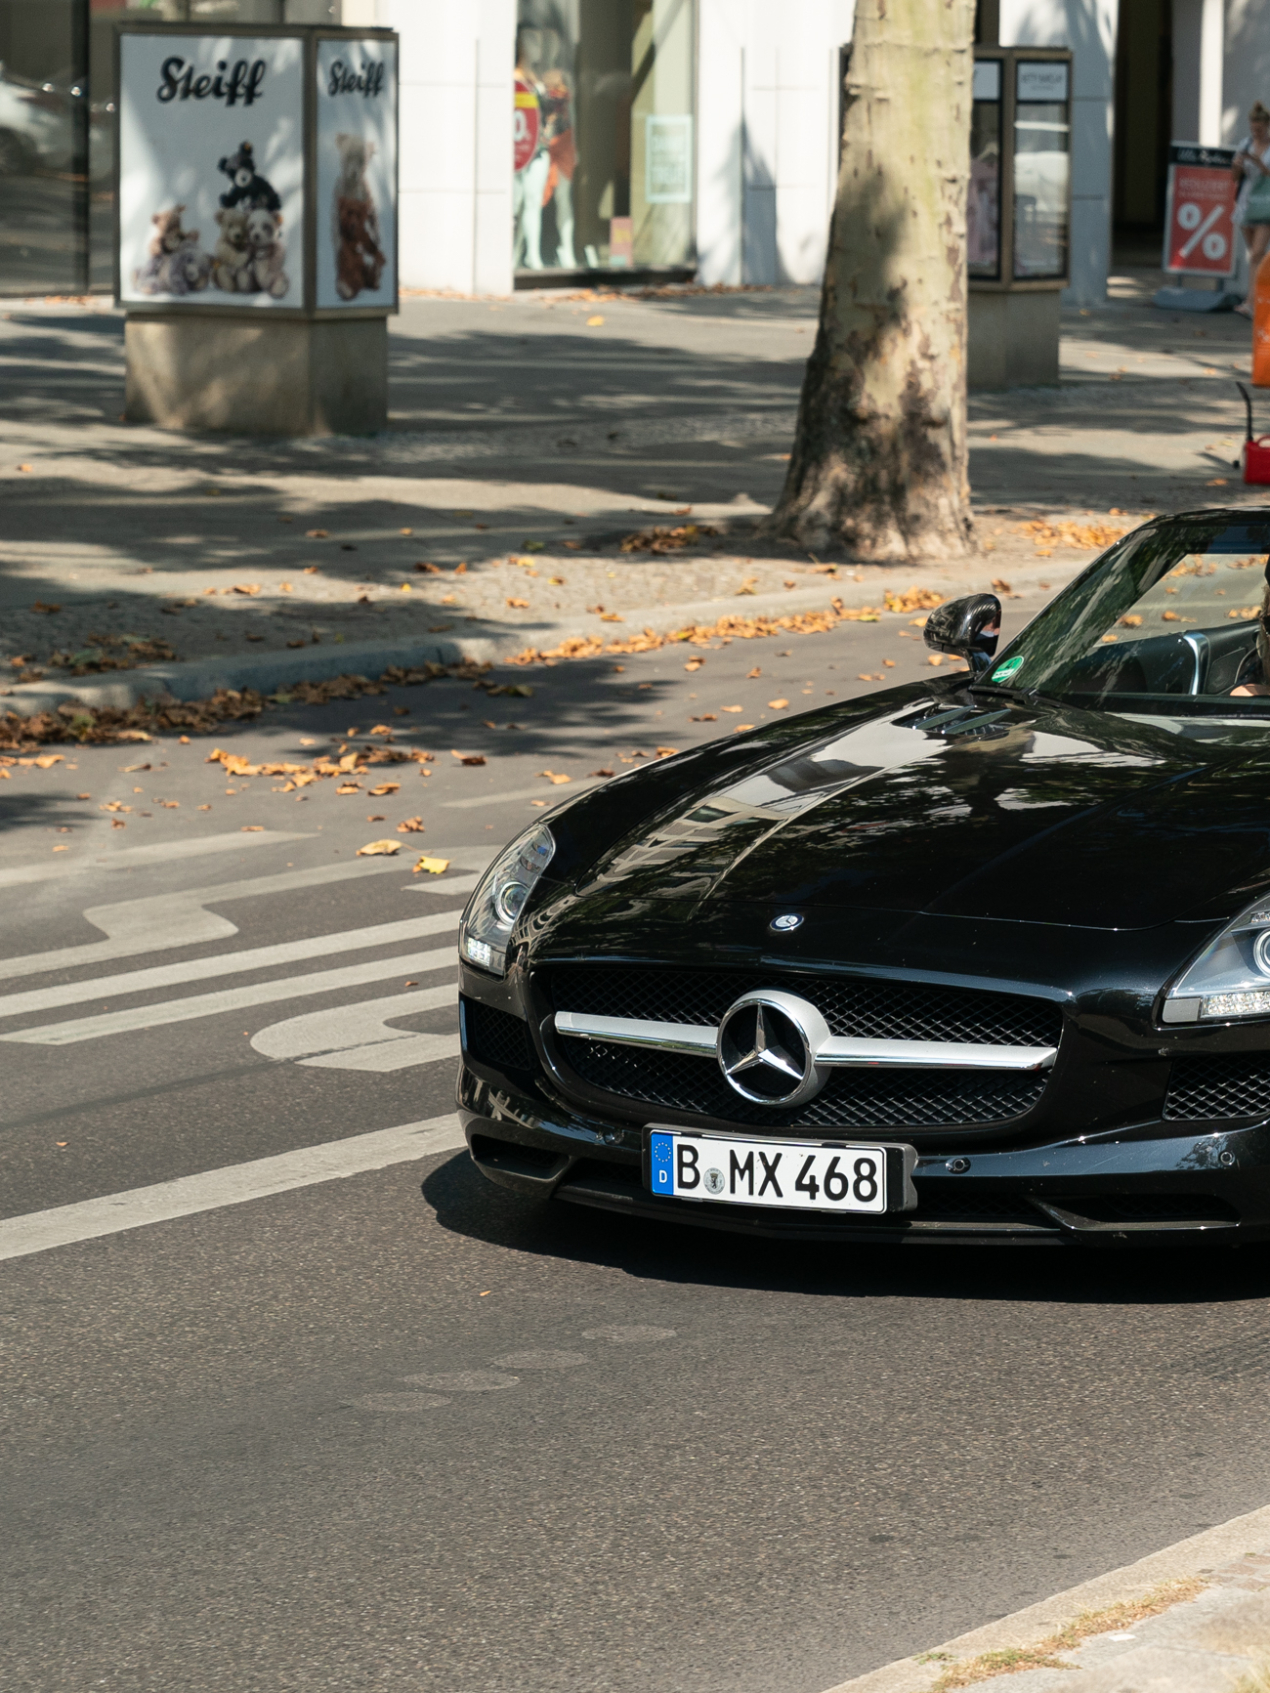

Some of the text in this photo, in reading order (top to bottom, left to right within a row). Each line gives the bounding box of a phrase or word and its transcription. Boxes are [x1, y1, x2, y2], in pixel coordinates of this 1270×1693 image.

[156, 55, 267, 107] Steiff
[328, 59, 384, 98] Steiff
[658, 1169, 668, 1183] D
[677, 1144, 700, 1189] B
[729, 1149, 783, 1198] MX
[795, 1155, 878, 1202] 468
